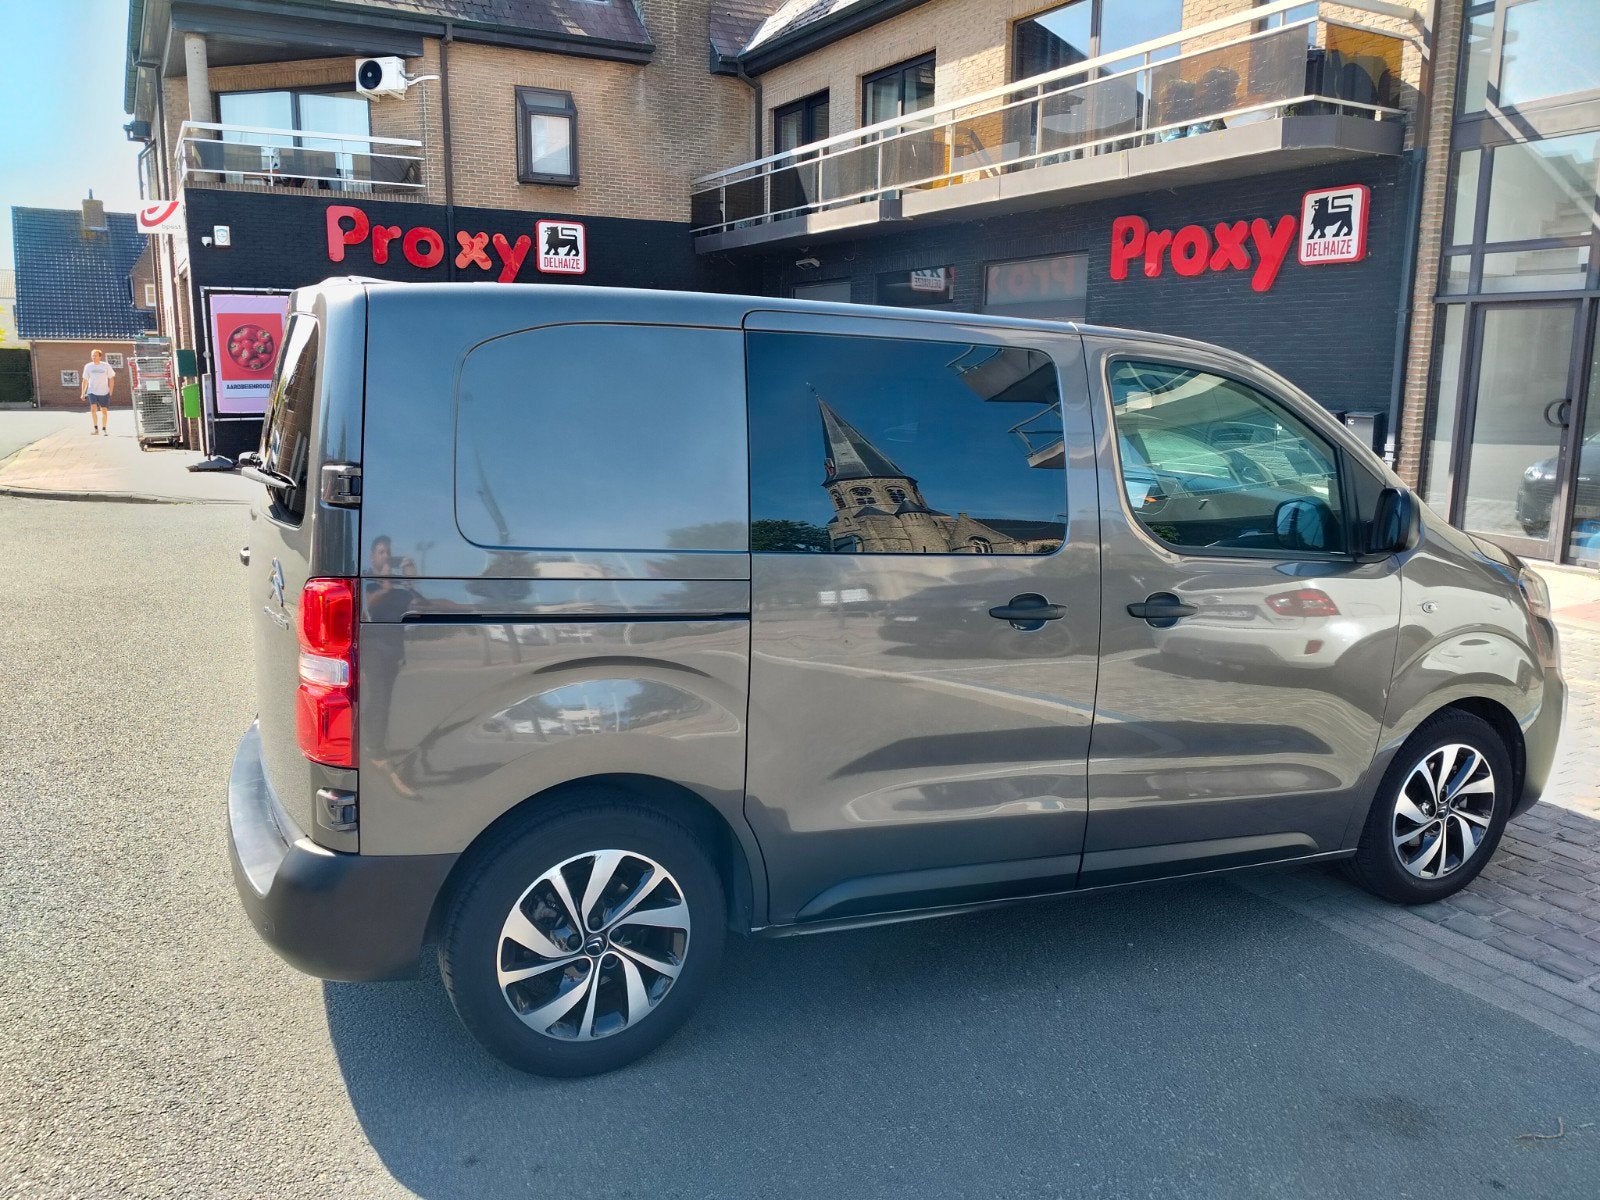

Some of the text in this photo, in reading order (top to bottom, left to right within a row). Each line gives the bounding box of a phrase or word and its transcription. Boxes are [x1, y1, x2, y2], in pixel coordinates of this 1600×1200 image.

[326, 205, 531, 283] Proxy
[543, 256, 581, 270] DELHAIZE
[1110, 214, 1298, 293] Proxy
[1305, 238, 1352, 258] DELHAIZE
